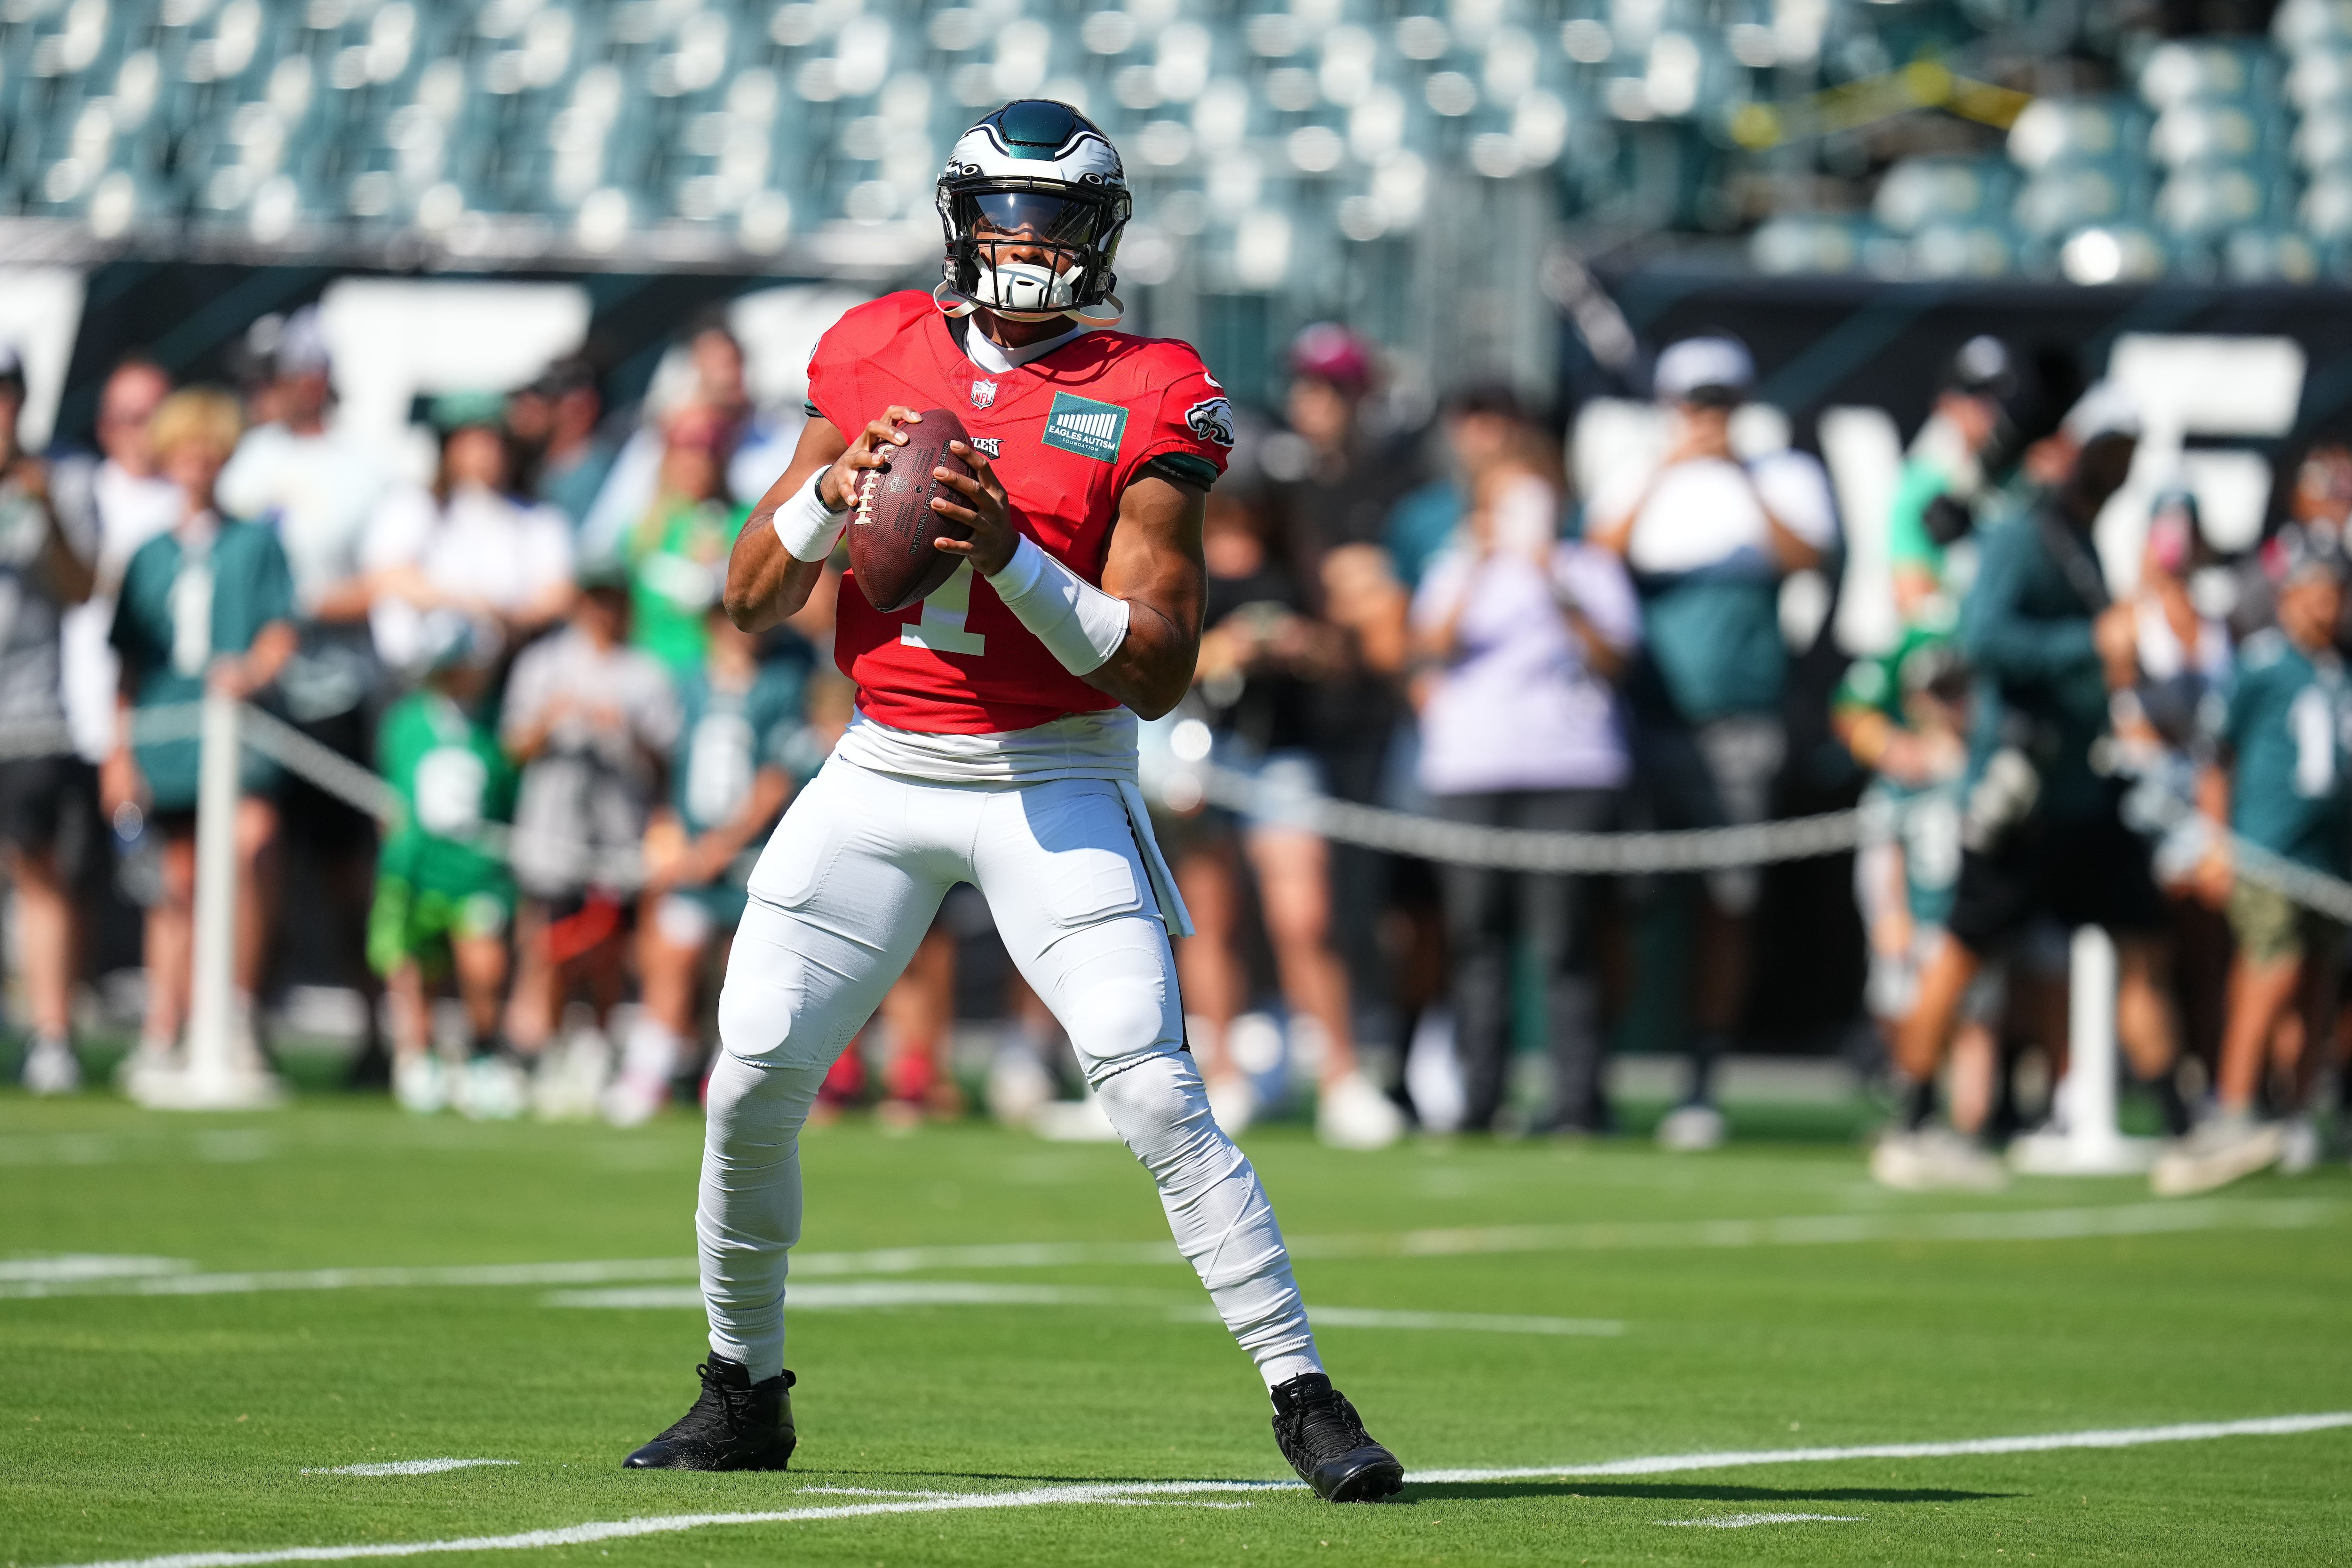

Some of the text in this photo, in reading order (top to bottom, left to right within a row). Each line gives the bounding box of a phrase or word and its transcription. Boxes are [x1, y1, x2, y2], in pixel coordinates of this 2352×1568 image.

[974, 392, 990, 404] NFL
[970, 437, 1006, 460] LES
[1049, 425, 1116, 451] EAGLES AUTISM
[1062, 438, 1099, 451] FOUNDATION
[910, 513, 928, 555] NATIONAL
[924, 478, 938, 510] FOOTBA
[900, 556, 985, 656] 1
